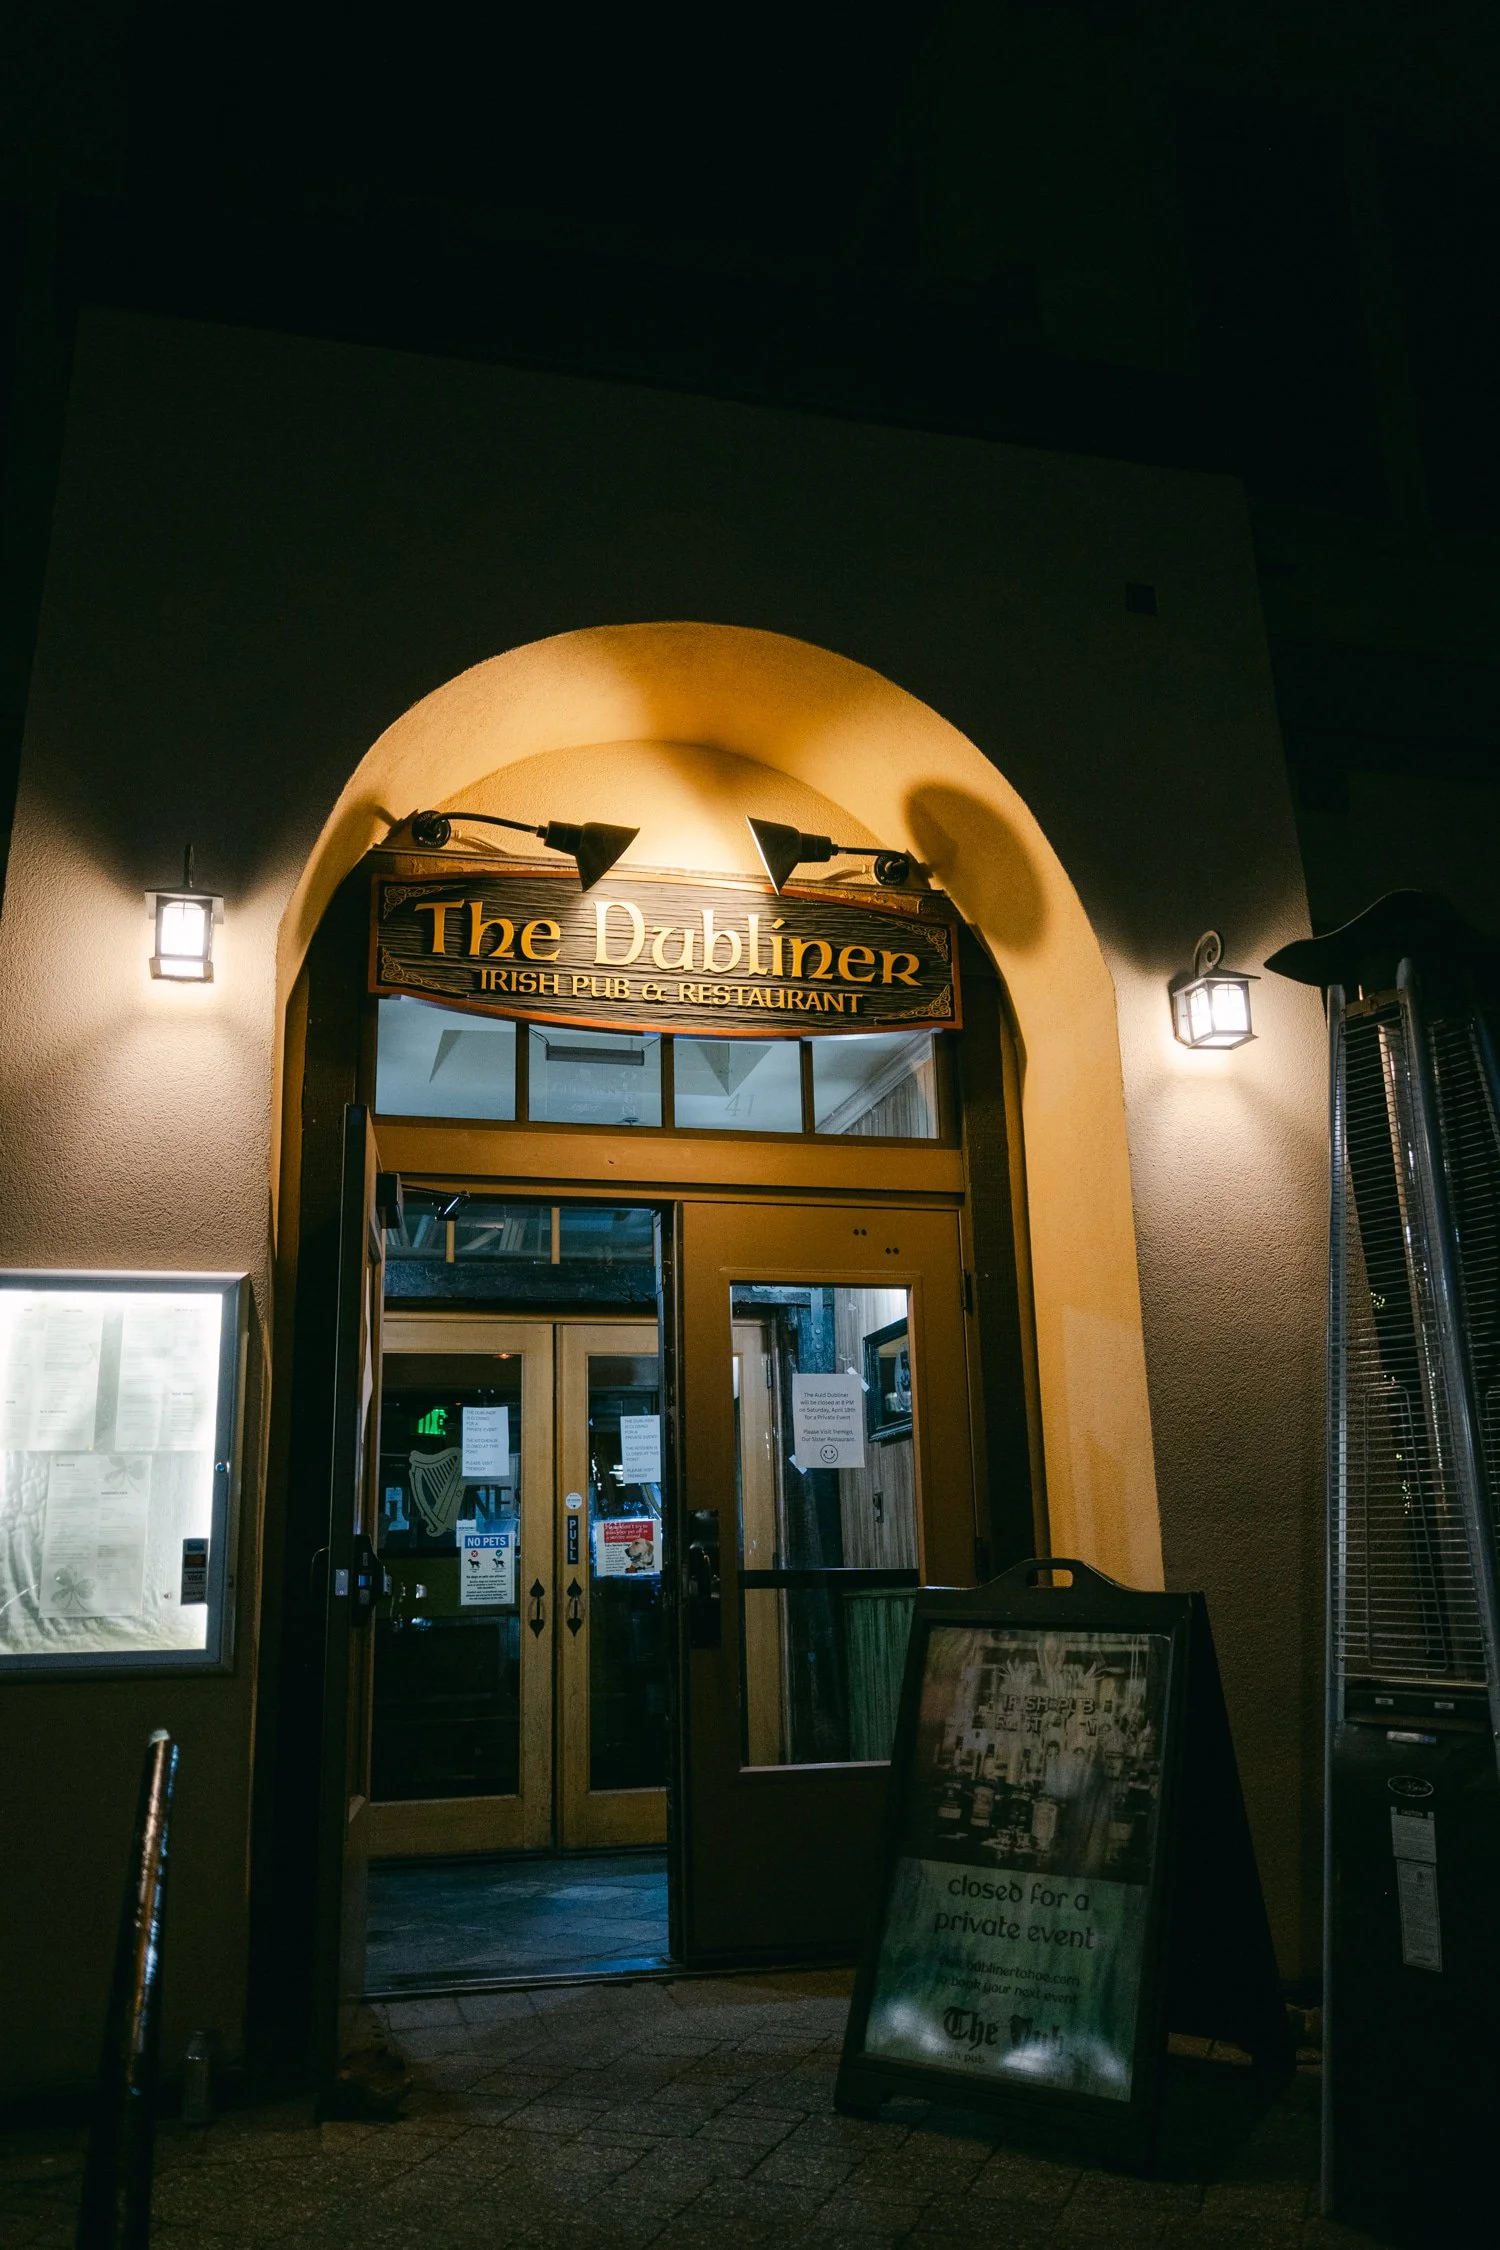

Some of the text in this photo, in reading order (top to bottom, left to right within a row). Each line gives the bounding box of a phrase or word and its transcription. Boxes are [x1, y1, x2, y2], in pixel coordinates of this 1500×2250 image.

[415, 899, 923, 988] The Dubliner
[481, 969, 864, 1013] IRISH PUB & RESTAURANT
[467, 1536, 506, 1547] NO PETS
[948, 1875, 1091, 1911] closed for a
[934, 1911, 1095, 1949] private event
[944, 2006, 998, 2051] The
